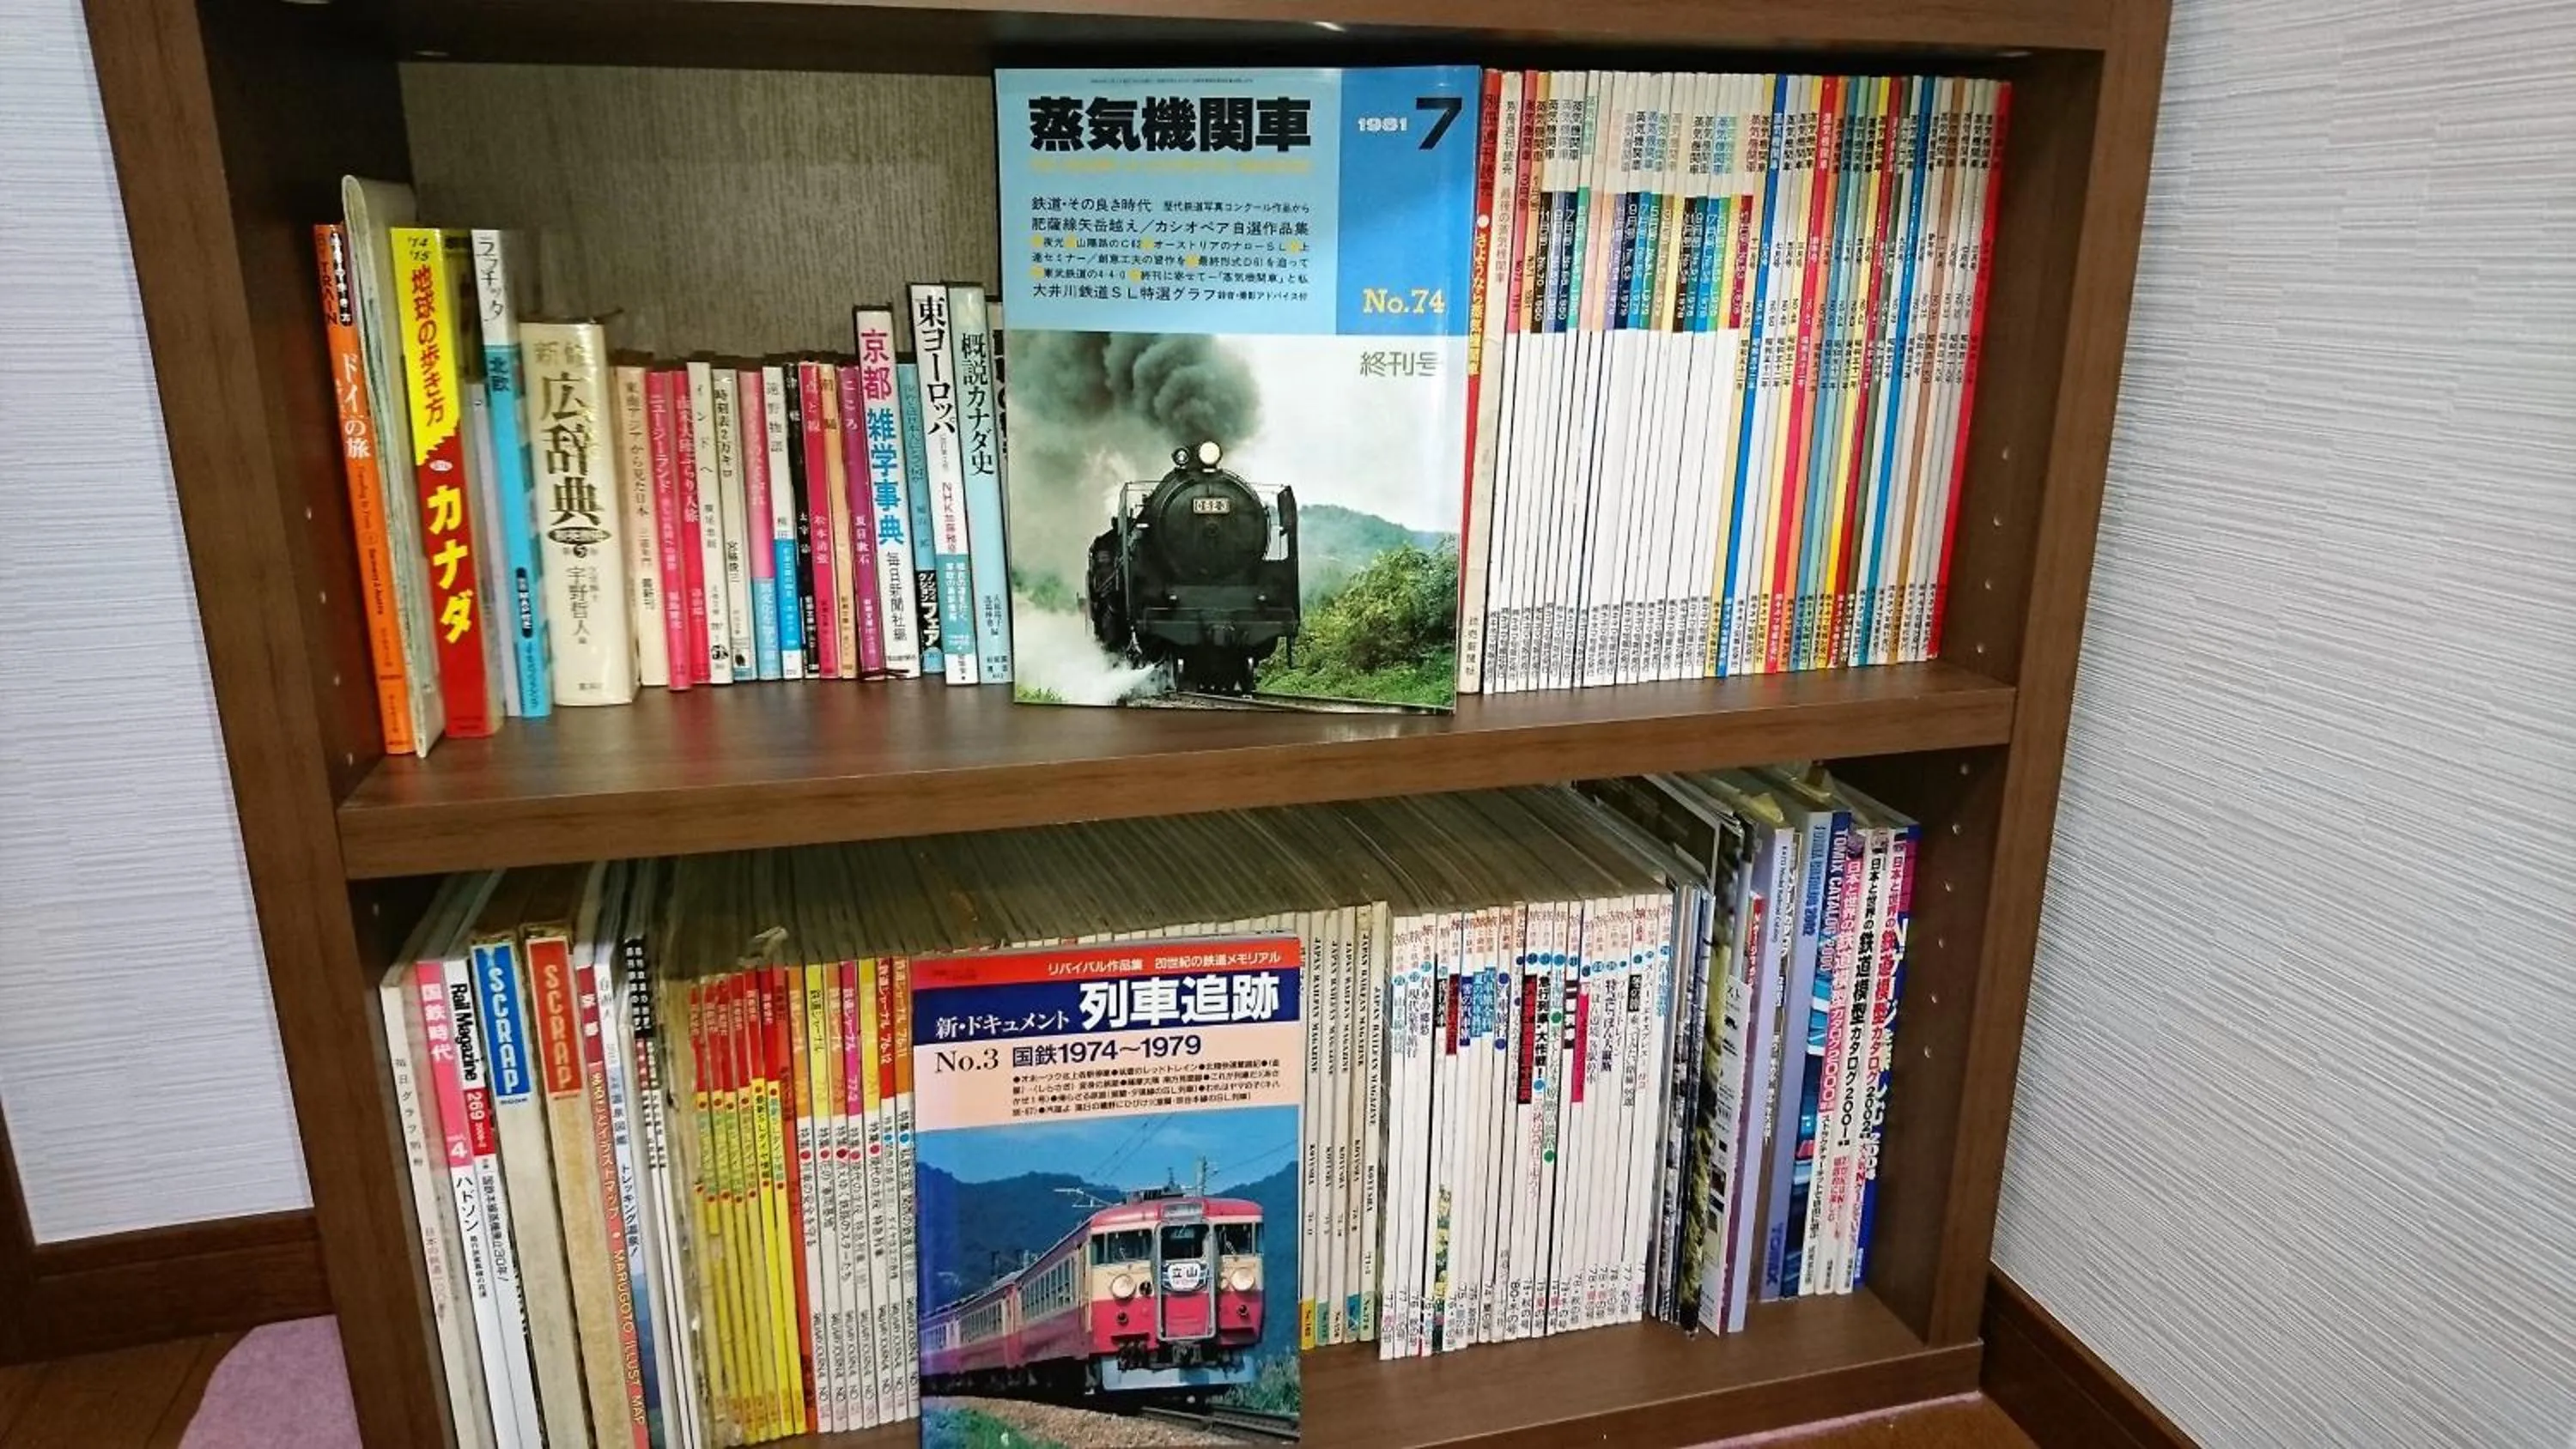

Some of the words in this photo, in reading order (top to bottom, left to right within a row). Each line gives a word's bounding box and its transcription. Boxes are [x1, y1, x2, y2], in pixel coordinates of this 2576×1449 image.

[1029, 95, 1311, 152] 蒸気機関車
[1357, 117, 1409, 133] 1981
[1414, 97, 1463, 150] 7
[1362, 287, 1447, 314] No.74
[410, 264, 445, 427] 地球の歩き方
[917, 294, 956, 436] 東ヨーロッパ
[1358, 350, 1443, 378] 終刊号
[489, 355, 509, 392] 北欧
[342, 353, 371, 458] ドイの旅
[961, 332, 995, 476] 概説カナダ史
[541, 372, 603, 526] 広辞典
[860, 328, 904, 545] 京都雑学事典
[427, 484, 474, 645] カナダ
[921, 602, 942, 646] フェア
[1827, 828, 1847, 873] TOMIX
[1821, 876, 1843, 936] CATALOG
[1048, 957, 1144, 976] リバイバル作品集
[1154, 952, 1281, 971] 20世紀の鉄道メモリアル
[1312, 937, 1324, 970] JAPAN
[1344, 941, 1354, 973] JAPAN
[1359, 933, 1370, 966] JAPAN
[451, 983, 470, 1009] Rail
[1078, 973, 1279, 1030] 列車追跡
[1309, 973, 1322, 1018] RAILFAN
[1341, 976, 1352, 1019] RAILFAN
[1358, 968, 1369, 1011] RAILFAN
[1372, 985, 1382, 1020] JAPAN
[455, 1011, 478, 1082] Magazine
[488, 970, 520, 1094] SCRAP
[542, 965, 574, 1090] SCRAP
[934, 1009, 1070, 1040] 新・ドキュメント
[1307, 1022, 1320, 1074] MAGAZINE
[1340, 1024, 1350, 1074] MAGAZINE
[1355, 1015, 1367, 1067] MAGAZINE
[1370, 1023, 1380, 1070] RAILFAN
[421, 983, 453, 1062] 国鉄時代
[450, 1143, 467, 1159] 4
[934, 1047, 1000, 1073] No.3
[466, 1091, 484, 1121] 269
[1368, 1074, 1378, 1126] MAGAZINE
[456, 1176, 479, 1233] ハドソン
[613, 1249, 633, 1332] MARUGOTO
[1172, 1266, 1198, 1278] 立山
[624, 1339, 640, 1388] ILLUST
[631, 1394, 645, 1427] MAP
